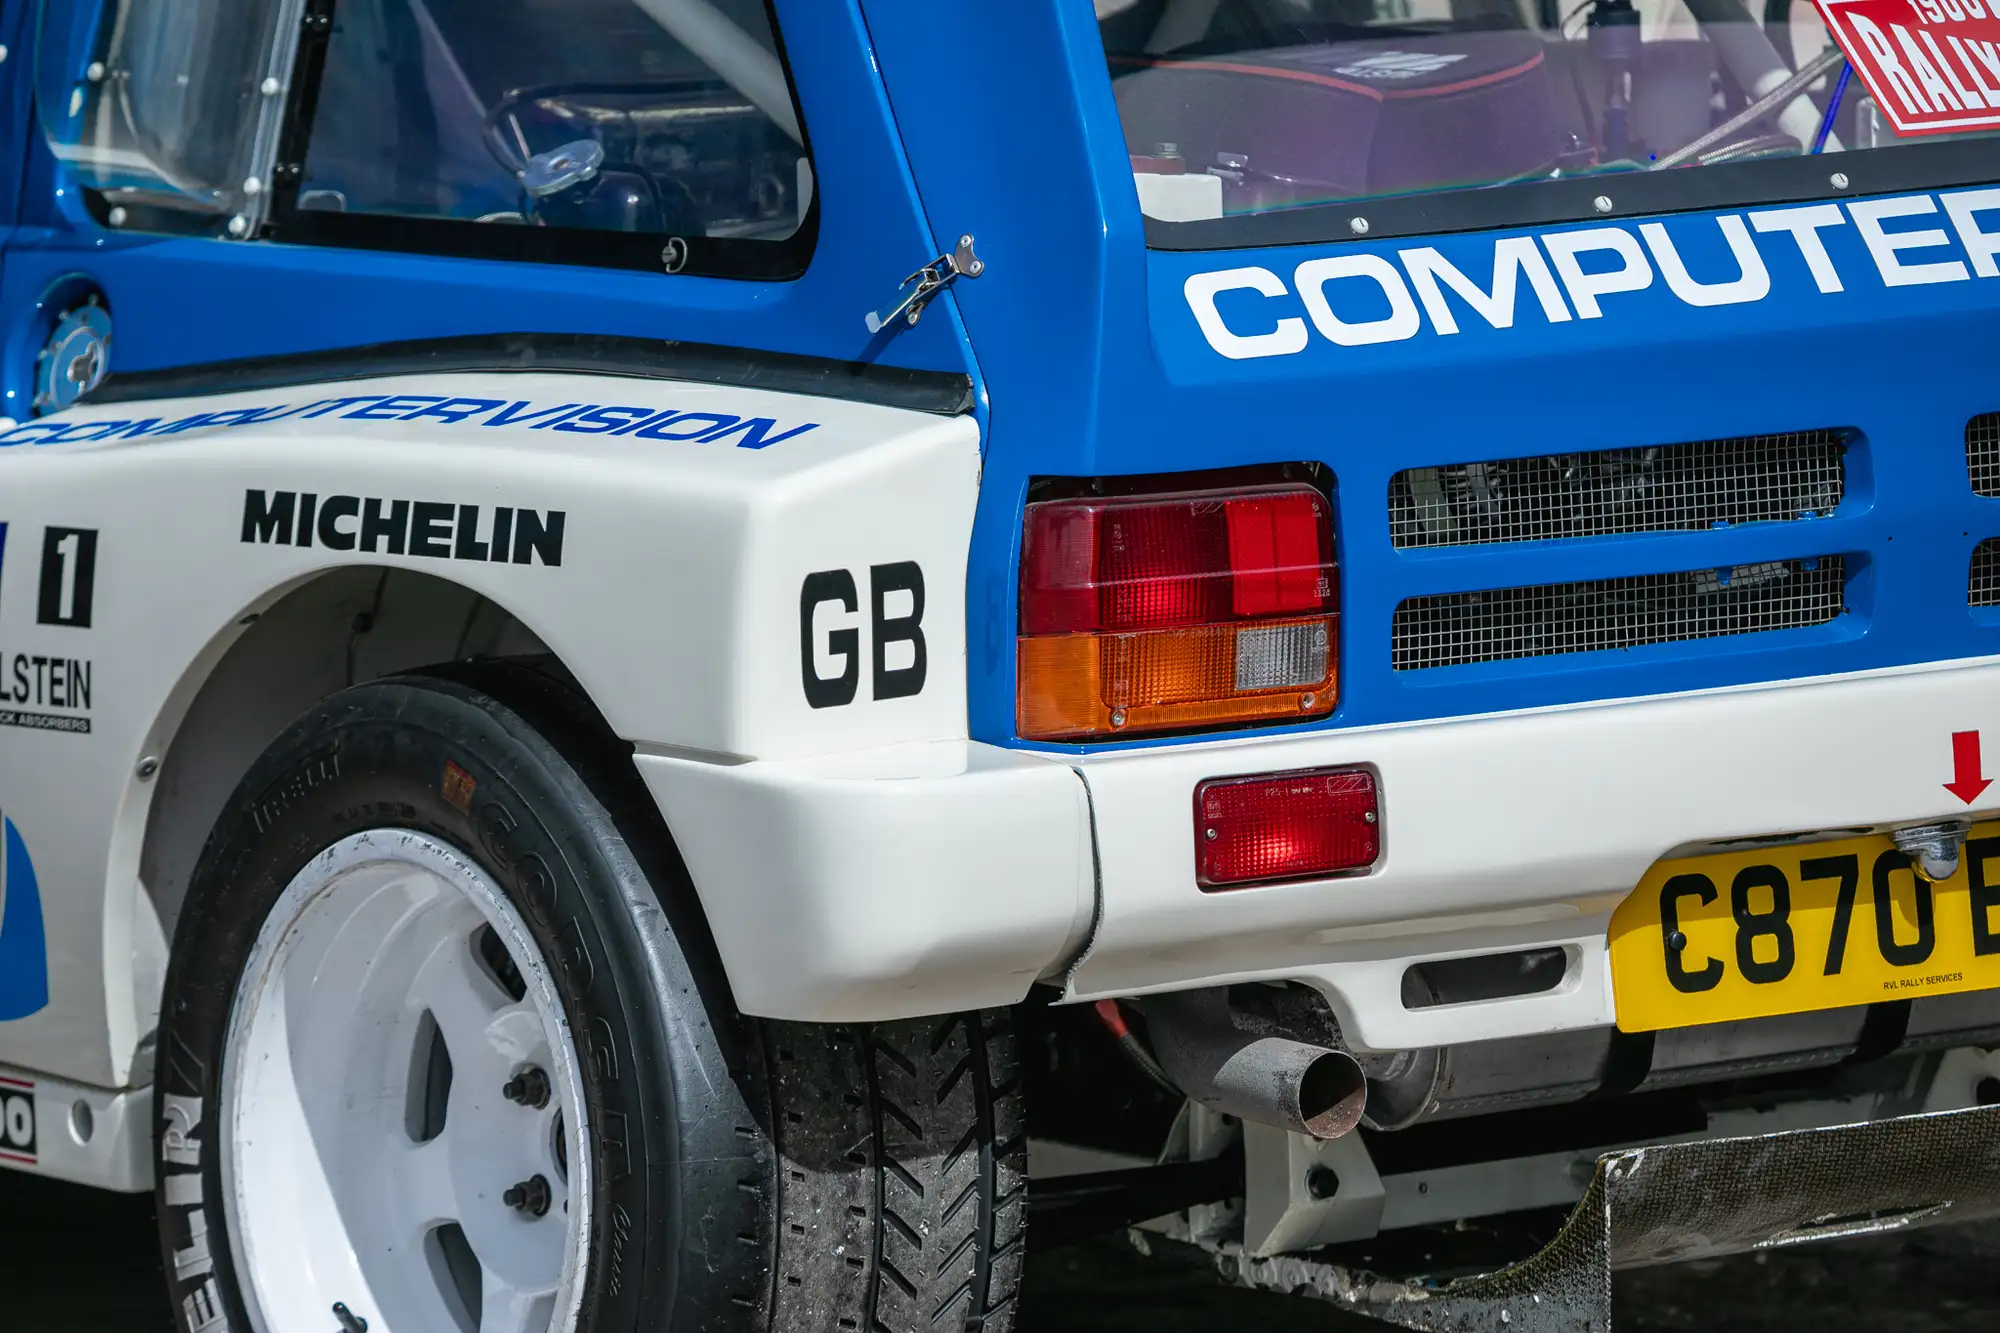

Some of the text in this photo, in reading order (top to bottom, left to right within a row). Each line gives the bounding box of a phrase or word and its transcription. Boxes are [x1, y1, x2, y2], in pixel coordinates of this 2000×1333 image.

[1845, 11, 2000, 115] RALLY
[0, 396, 820, 450] COMPUTERVISION
[241, 488, 566, 567] MICHELIN
[57, 533, 80, 620] 1
[800, 560, 928, 710] GB
[18, 714, 88, 732] ABSORBERS
[1659, 849, 1936, 994] C870
[480, 800, 632, 1190] CORSA
[1883, 972, 1963, 990] RVL RALLY SERVICES
